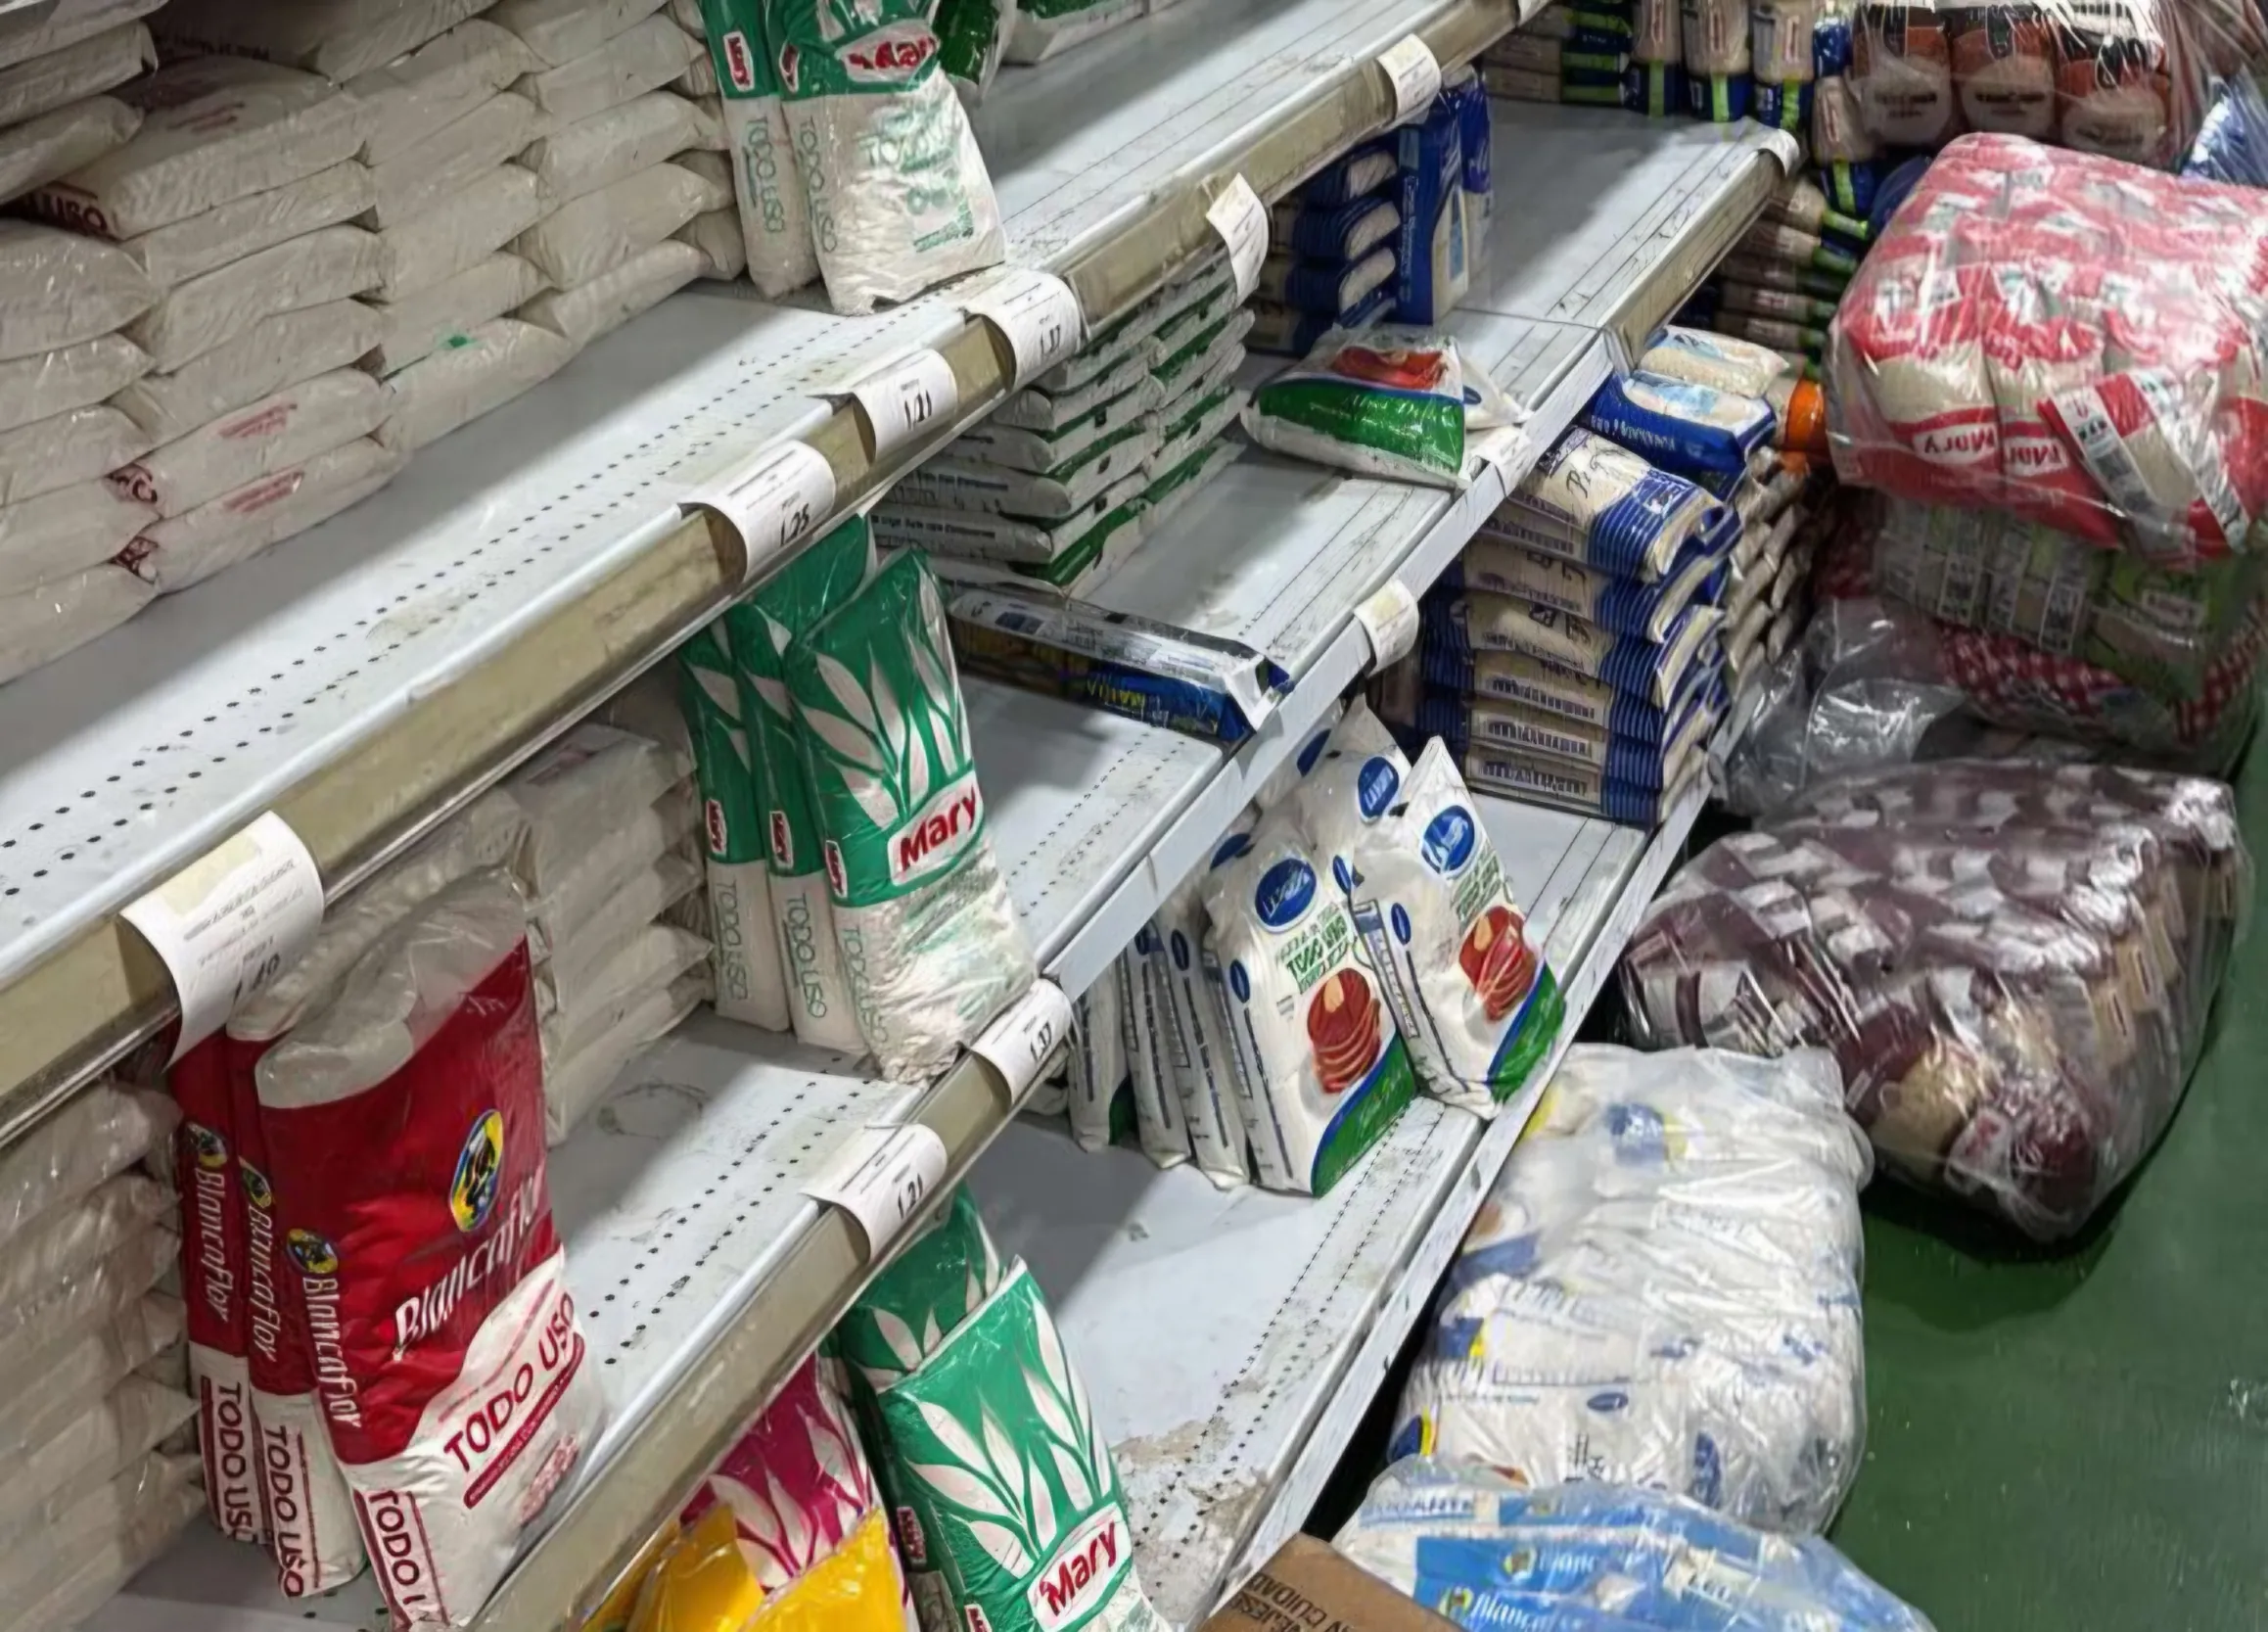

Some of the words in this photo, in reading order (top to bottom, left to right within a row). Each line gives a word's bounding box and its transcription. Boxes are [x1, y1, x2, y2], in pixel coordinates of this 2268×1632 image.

[900, 784, 978, 871] Mary
[717, 880, 741, 948] TODO
[787, 896, 815, 971] TODO
[800, 972, 828, 1018] USO
[197, 1167, 234, 1323] Blancaflor
[249, 1205, 283, 1363] Blancaflor
[303, 1277, 362, 1429] Blancaflor
[443, 1362, 534, 1472] TODO
[538, 1291, 575, 1372] USO
[217, 1381, 248, 1479] TODO
[264, 1424, 298, 1522] TODO
[277, 1530, 304, 1598] USO
[368, 1489, 421, 1587] TODO
[1038, 1518, 1120, 1617] Mary
